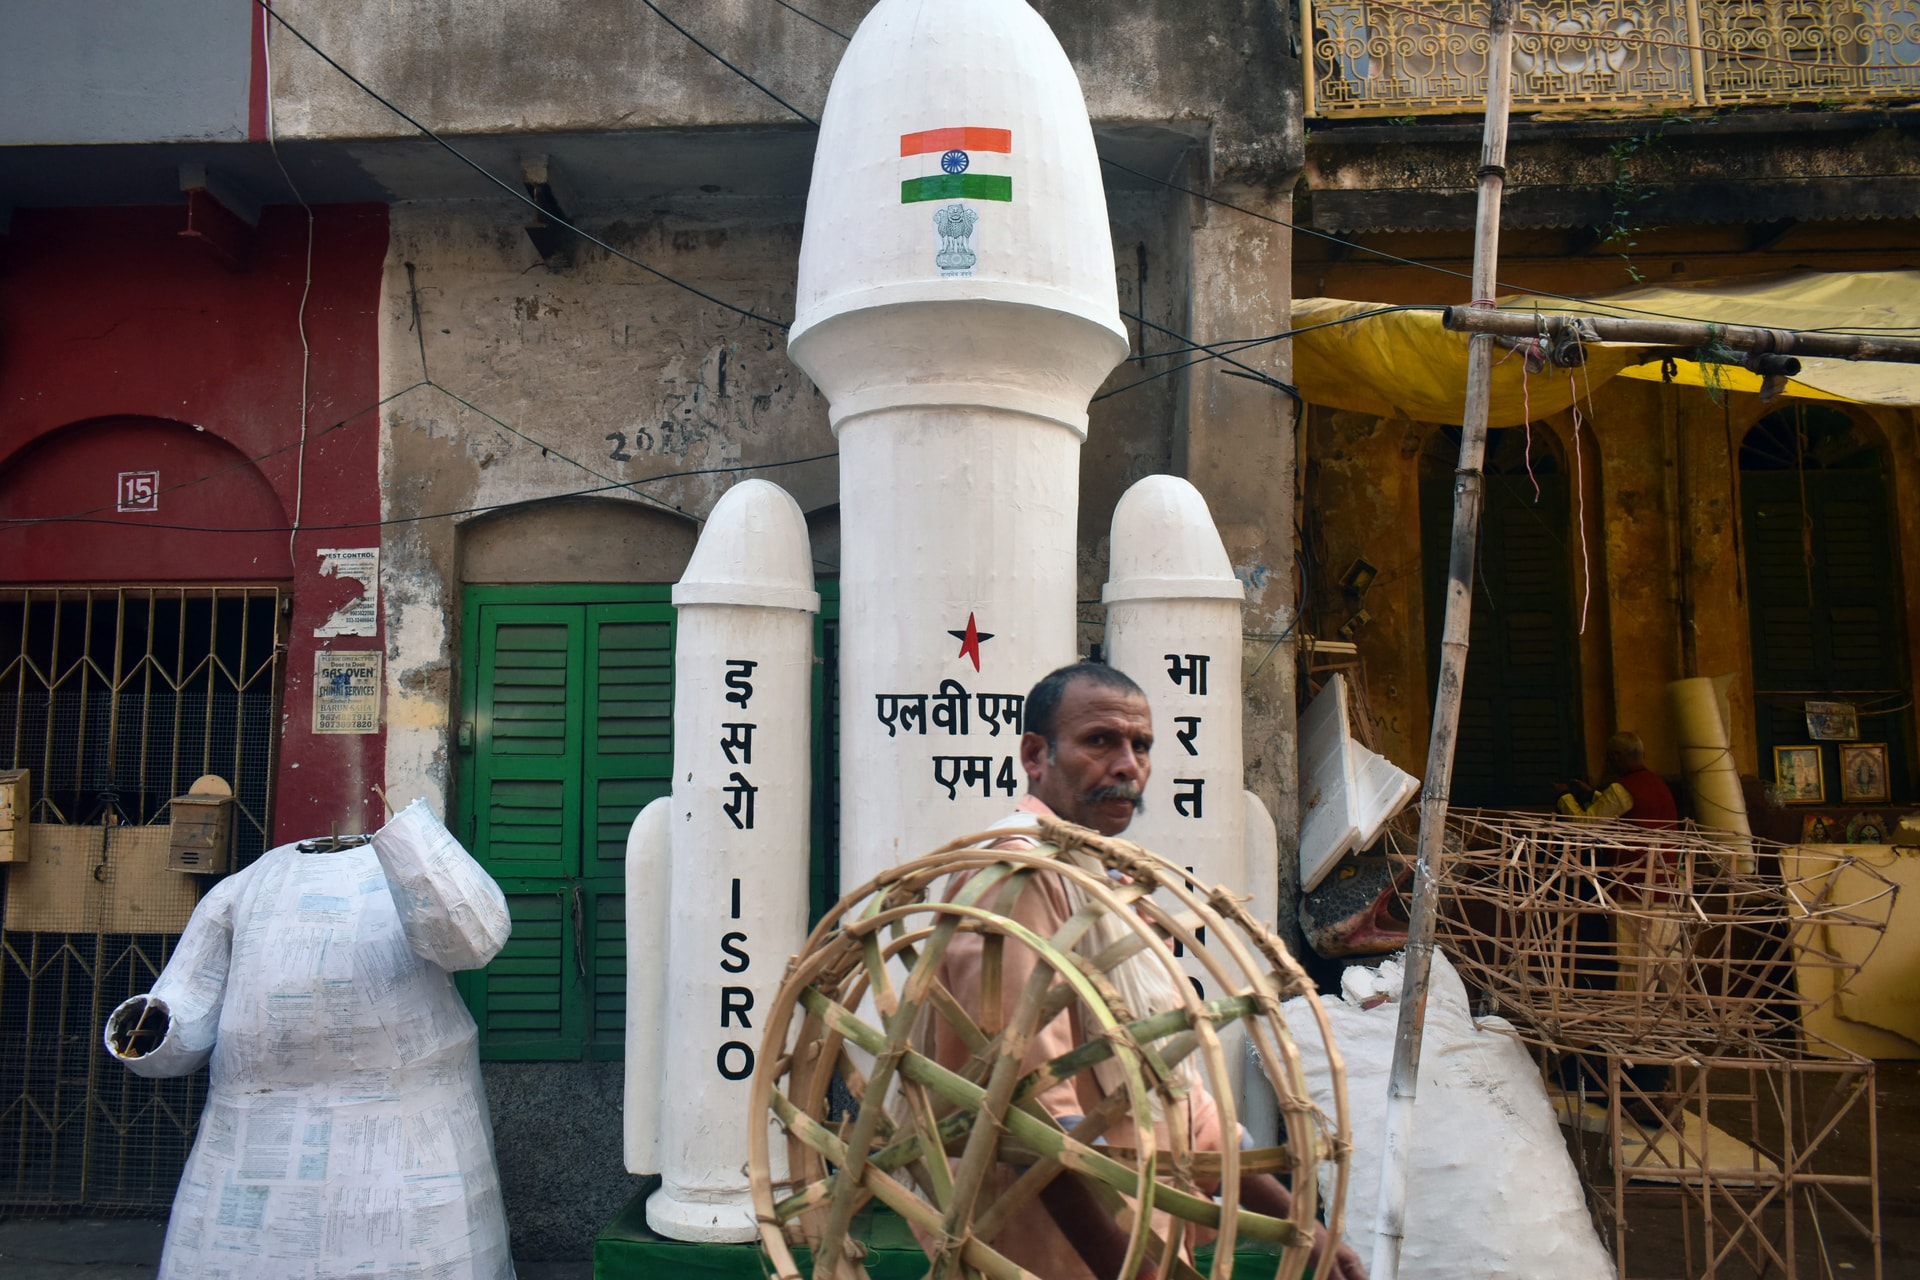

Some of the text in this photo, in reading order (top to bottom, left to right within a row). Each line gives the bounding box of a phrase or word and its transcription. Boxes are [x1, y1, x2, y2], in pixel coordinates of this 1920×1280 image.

[125, 477, 152, 504] 15
[322, 668, 374, 678] GAS OVEN
[345, 685, 375, 696] SERVICES
[1164, 654, 1210, 818] भारत
[717, 877, 756, 1081] ISRO
